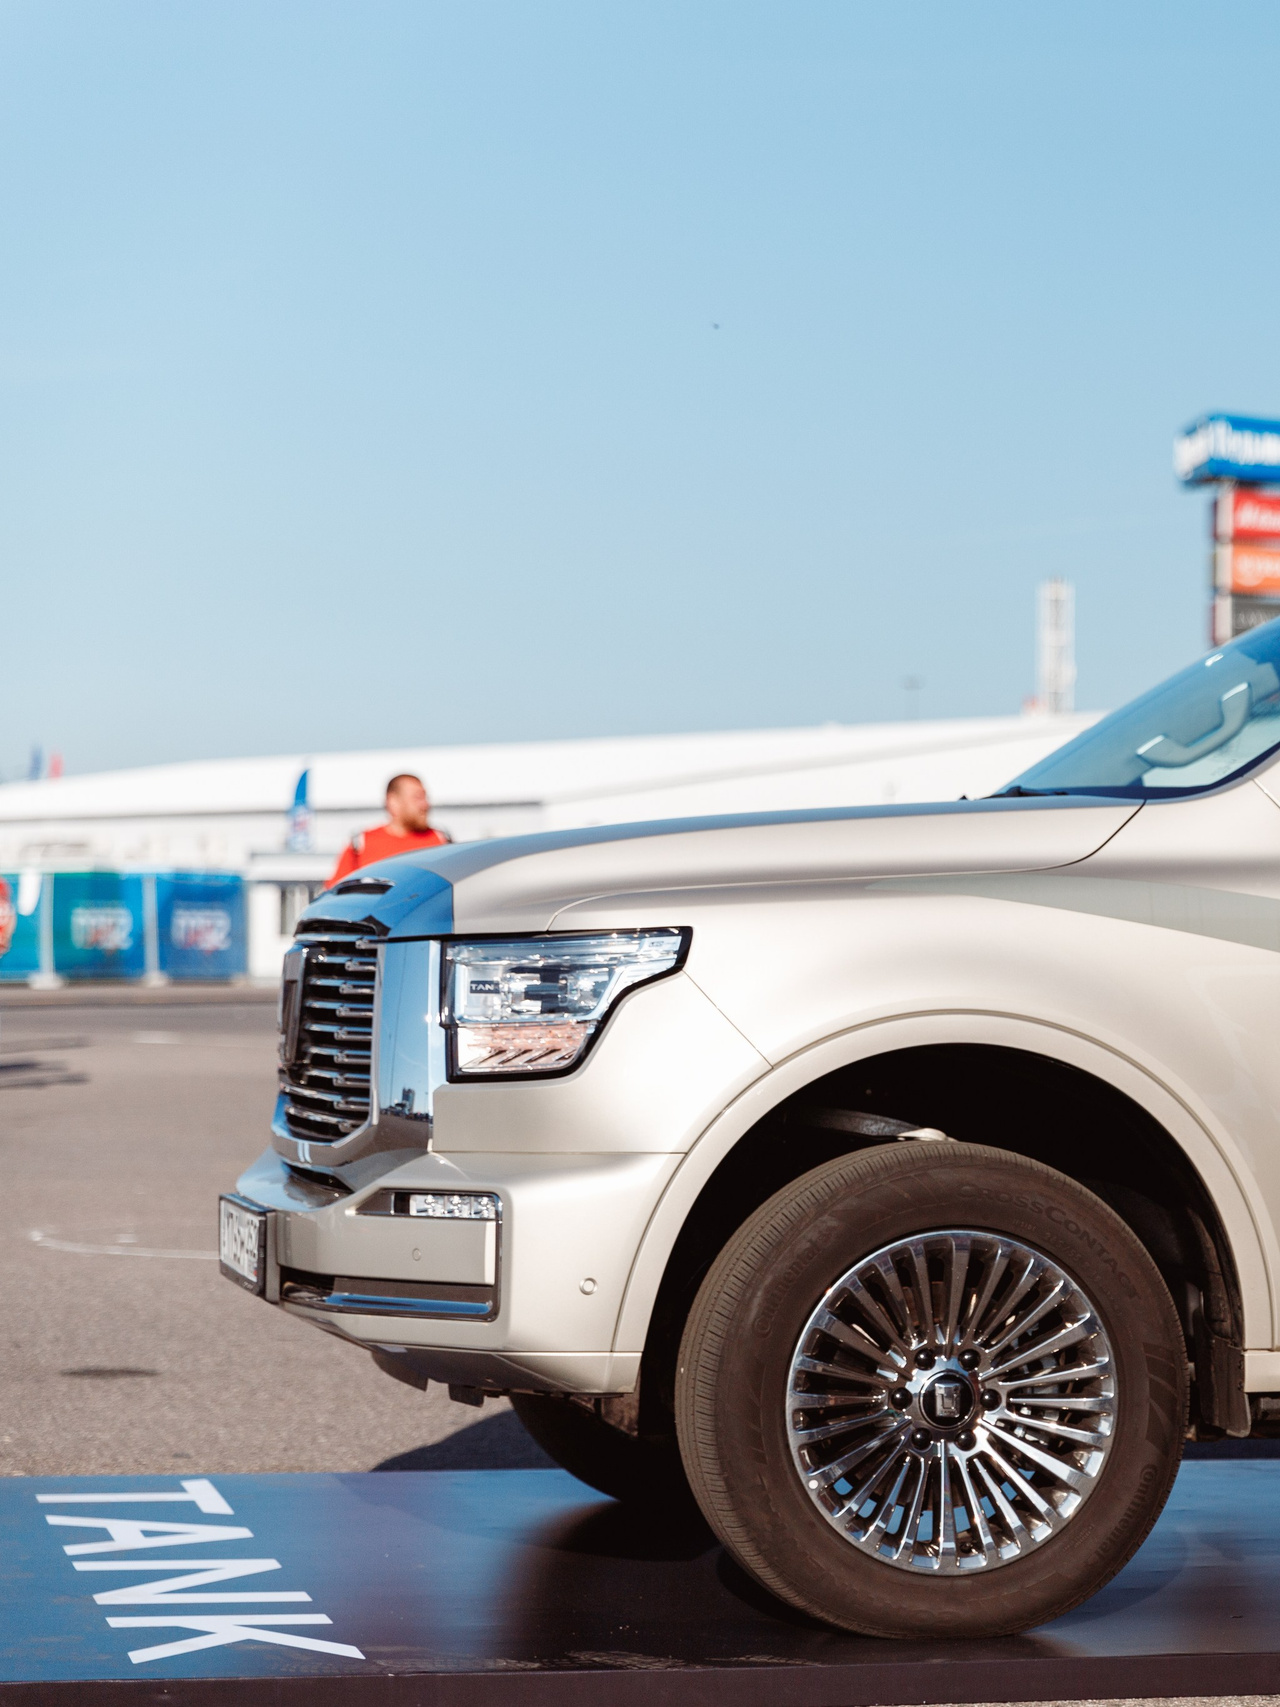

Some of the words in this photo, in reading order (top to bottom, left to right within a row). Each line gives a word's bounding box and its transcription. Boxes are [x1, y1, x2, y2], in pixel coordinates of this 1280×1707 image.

[470, 983, 500, 991] TAN
[753, 1240, 822, 1338] Continental
[1095, 1463, 1159, 1561] Continental
[35, 1478, 366, 1664] TANK
